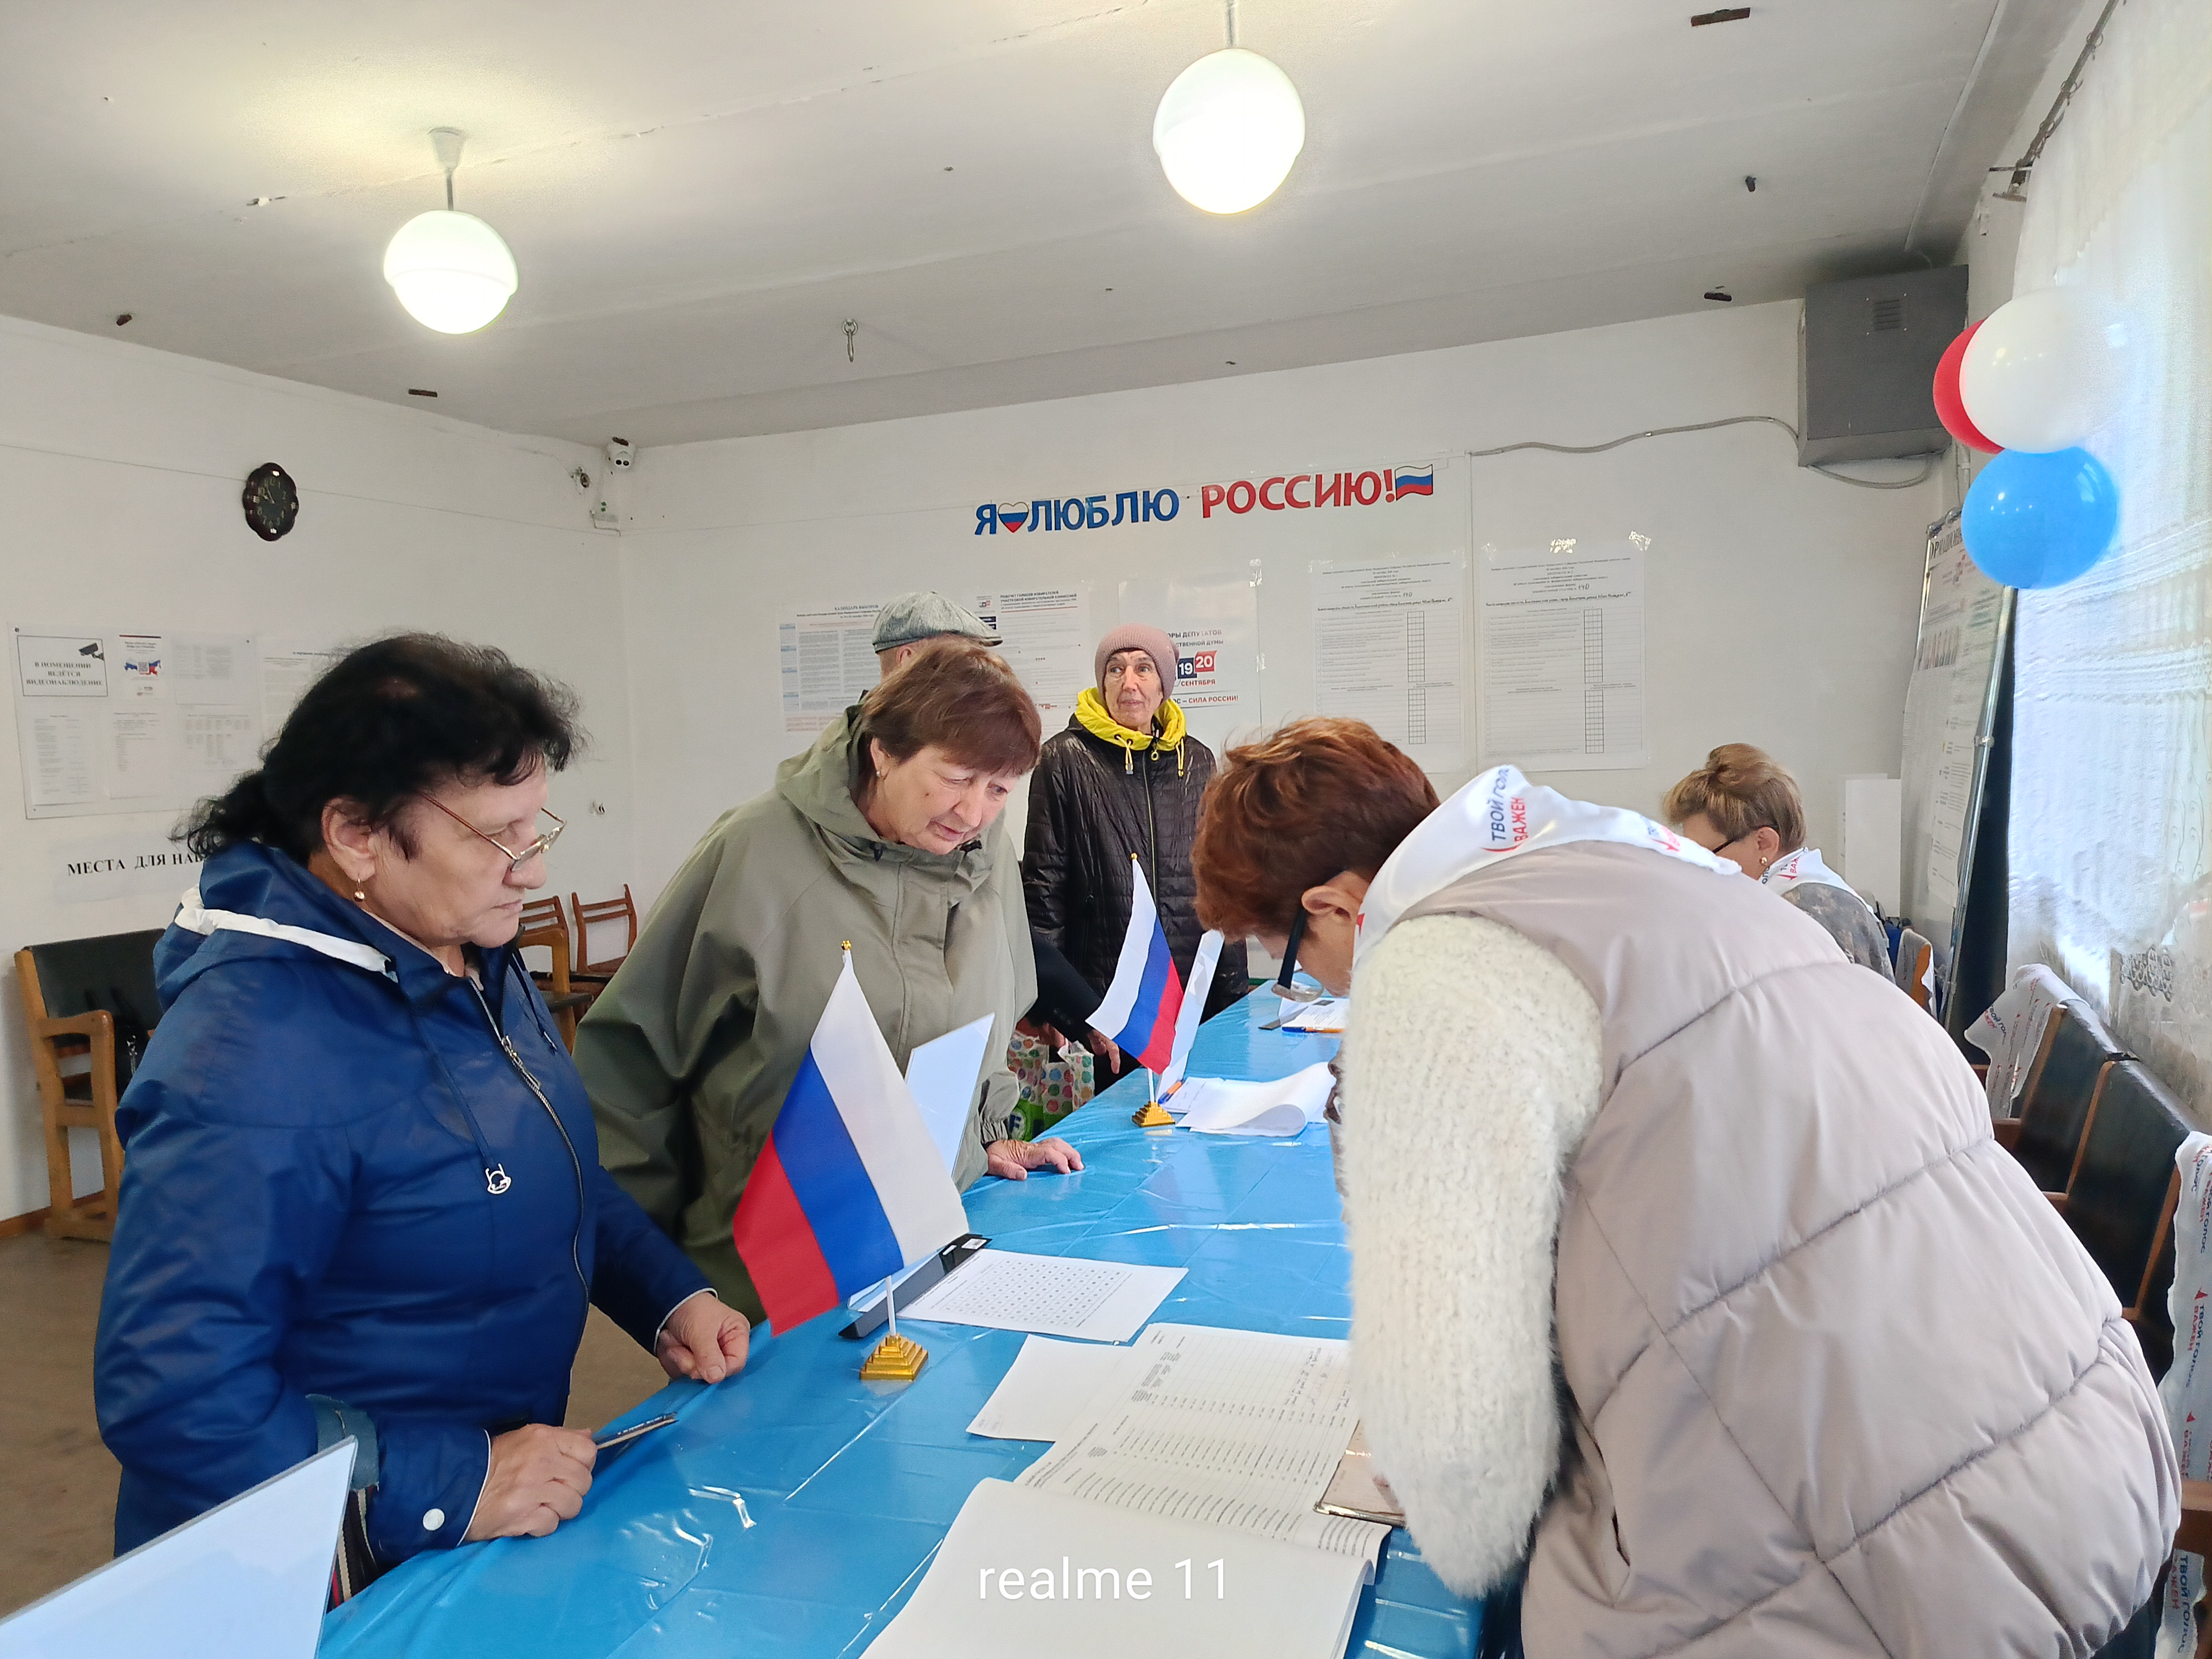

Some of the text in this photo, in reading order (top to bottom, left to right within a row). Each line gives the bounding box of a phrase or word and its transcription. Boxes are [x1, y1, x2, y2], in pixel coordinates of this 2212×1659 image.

[974, 468, 1395, 535] Я ЛЮБЛЮ РОССИЮ!
[1182, 629, 1222, 638] ДЕПУТАТОВ
[1178, 662, 1193, 675] 19
[1196, 655, 1213, 669] 20
[1486, 799, 1506, 841] ТВОЙ
[1511, 797, 1529, 842] ВАЖЕН
[67, 859, 126, 876] МЕСТА
[134, 853, 166, 870] ДЛЯ
[2200, 1211, 2210, 1254] ГОЛОС
[2188, 1306, 2199, 1351] ВАЖЕН
[2197, 1303, 2205, 1339] ТВОЙ
[2179, 1555, 2190, 1597] ТВОЙ
